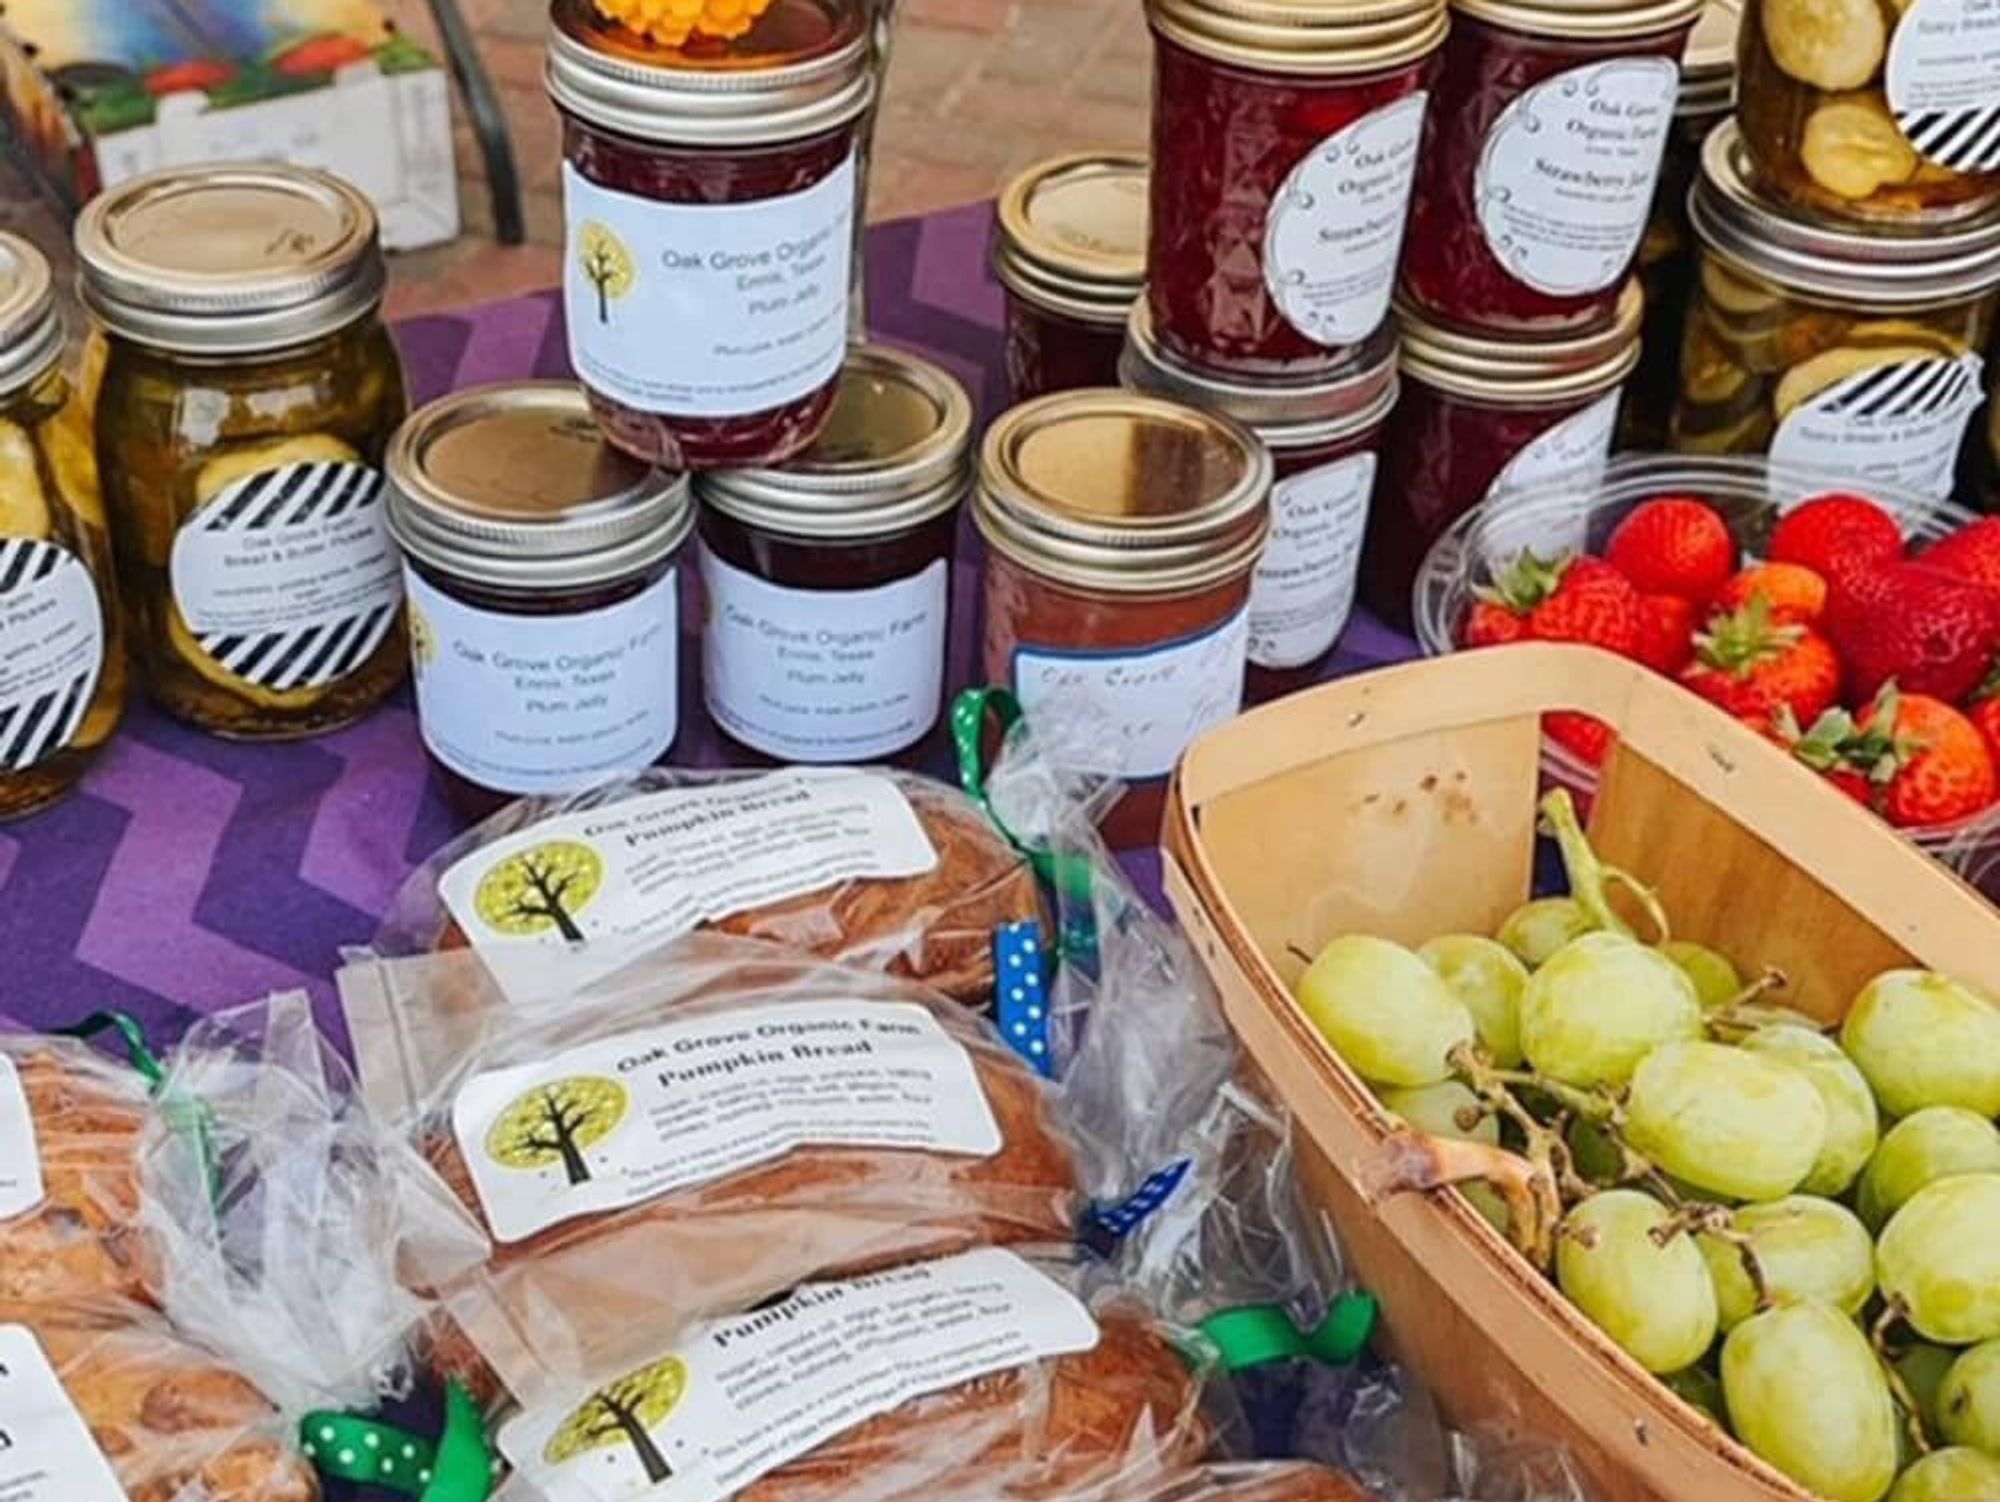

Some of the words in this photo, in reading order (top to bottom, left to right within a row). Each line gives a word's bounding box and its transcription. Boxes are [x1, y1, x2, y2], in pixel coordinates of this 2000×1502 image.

[662, 250, 702, 268] Oak
[709, 248, 771, 270] Grove
[759, 617, 809, 643] Grove
[491, 652, 550, 671] Grove
[625, 808, 736, 847] Pumpkin
[617, 1047, 669, 1073] Oak
[674, 1027, 751, 1056] Grove
[756, 1017, 855, 1041] Organic
[859, 1017, 921, 1036] Farm
[656, 1045, 786, 1089] Pumpkin
[790, 1038, 874, 1062] Bread
[712, 1285, 846, 1349] Pumpkin
